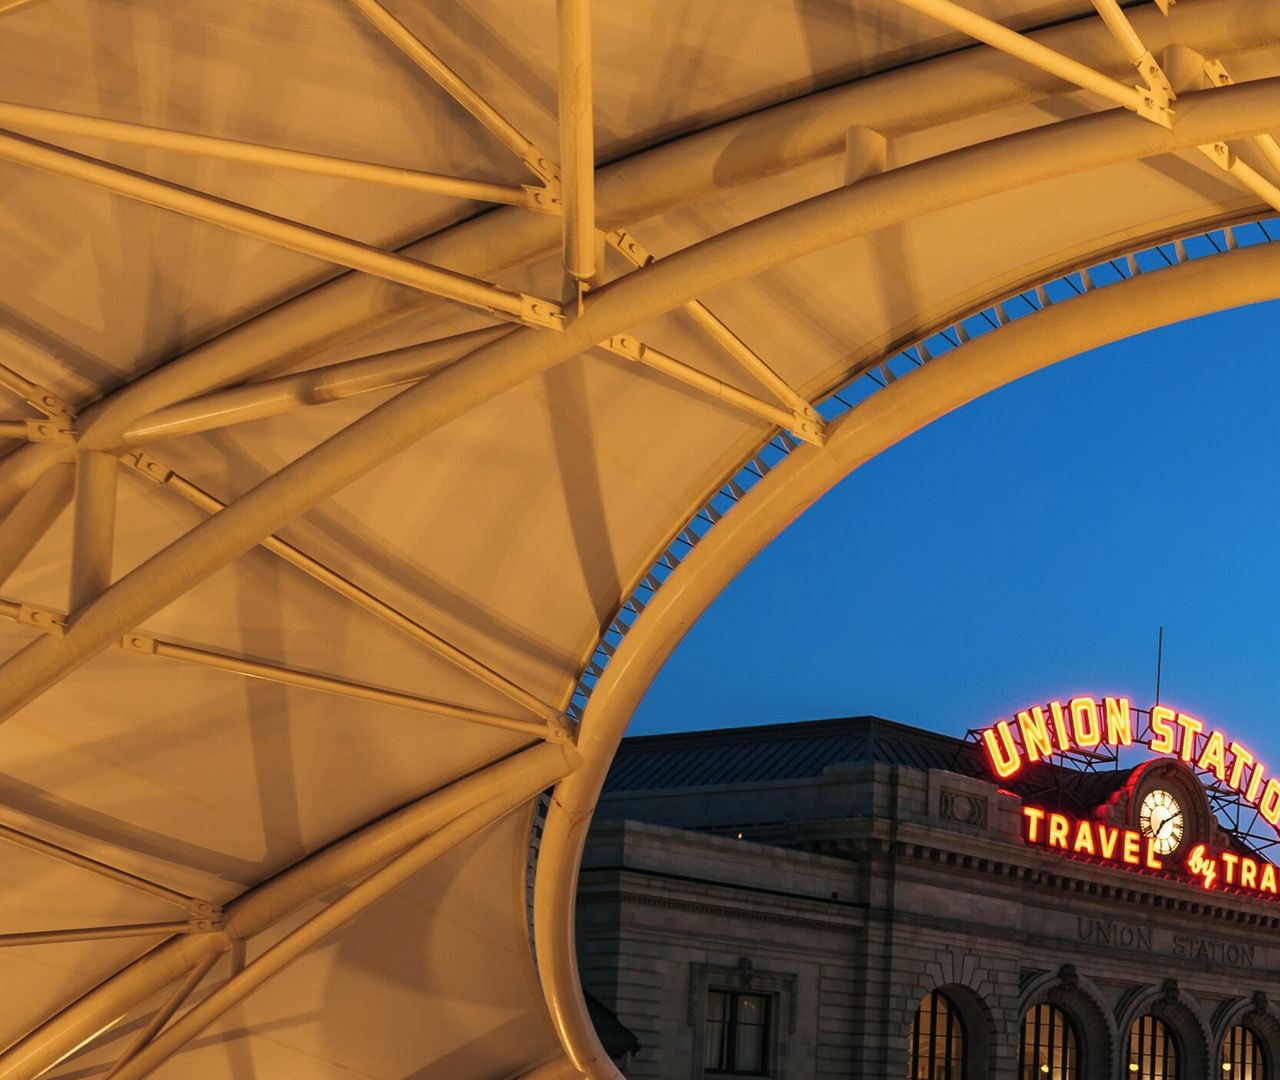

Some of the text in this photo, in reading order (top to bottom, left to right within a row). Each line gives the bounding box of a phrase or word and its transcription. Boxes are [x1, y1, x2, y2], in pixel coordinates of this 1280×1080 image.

[981, 696, 1133, 778] UNION
[1023, 805, 1163, 870] TRAVEL
[1187, 844, 1217, 889] by
[1077, 917, 1256, 968] UNION STATION
